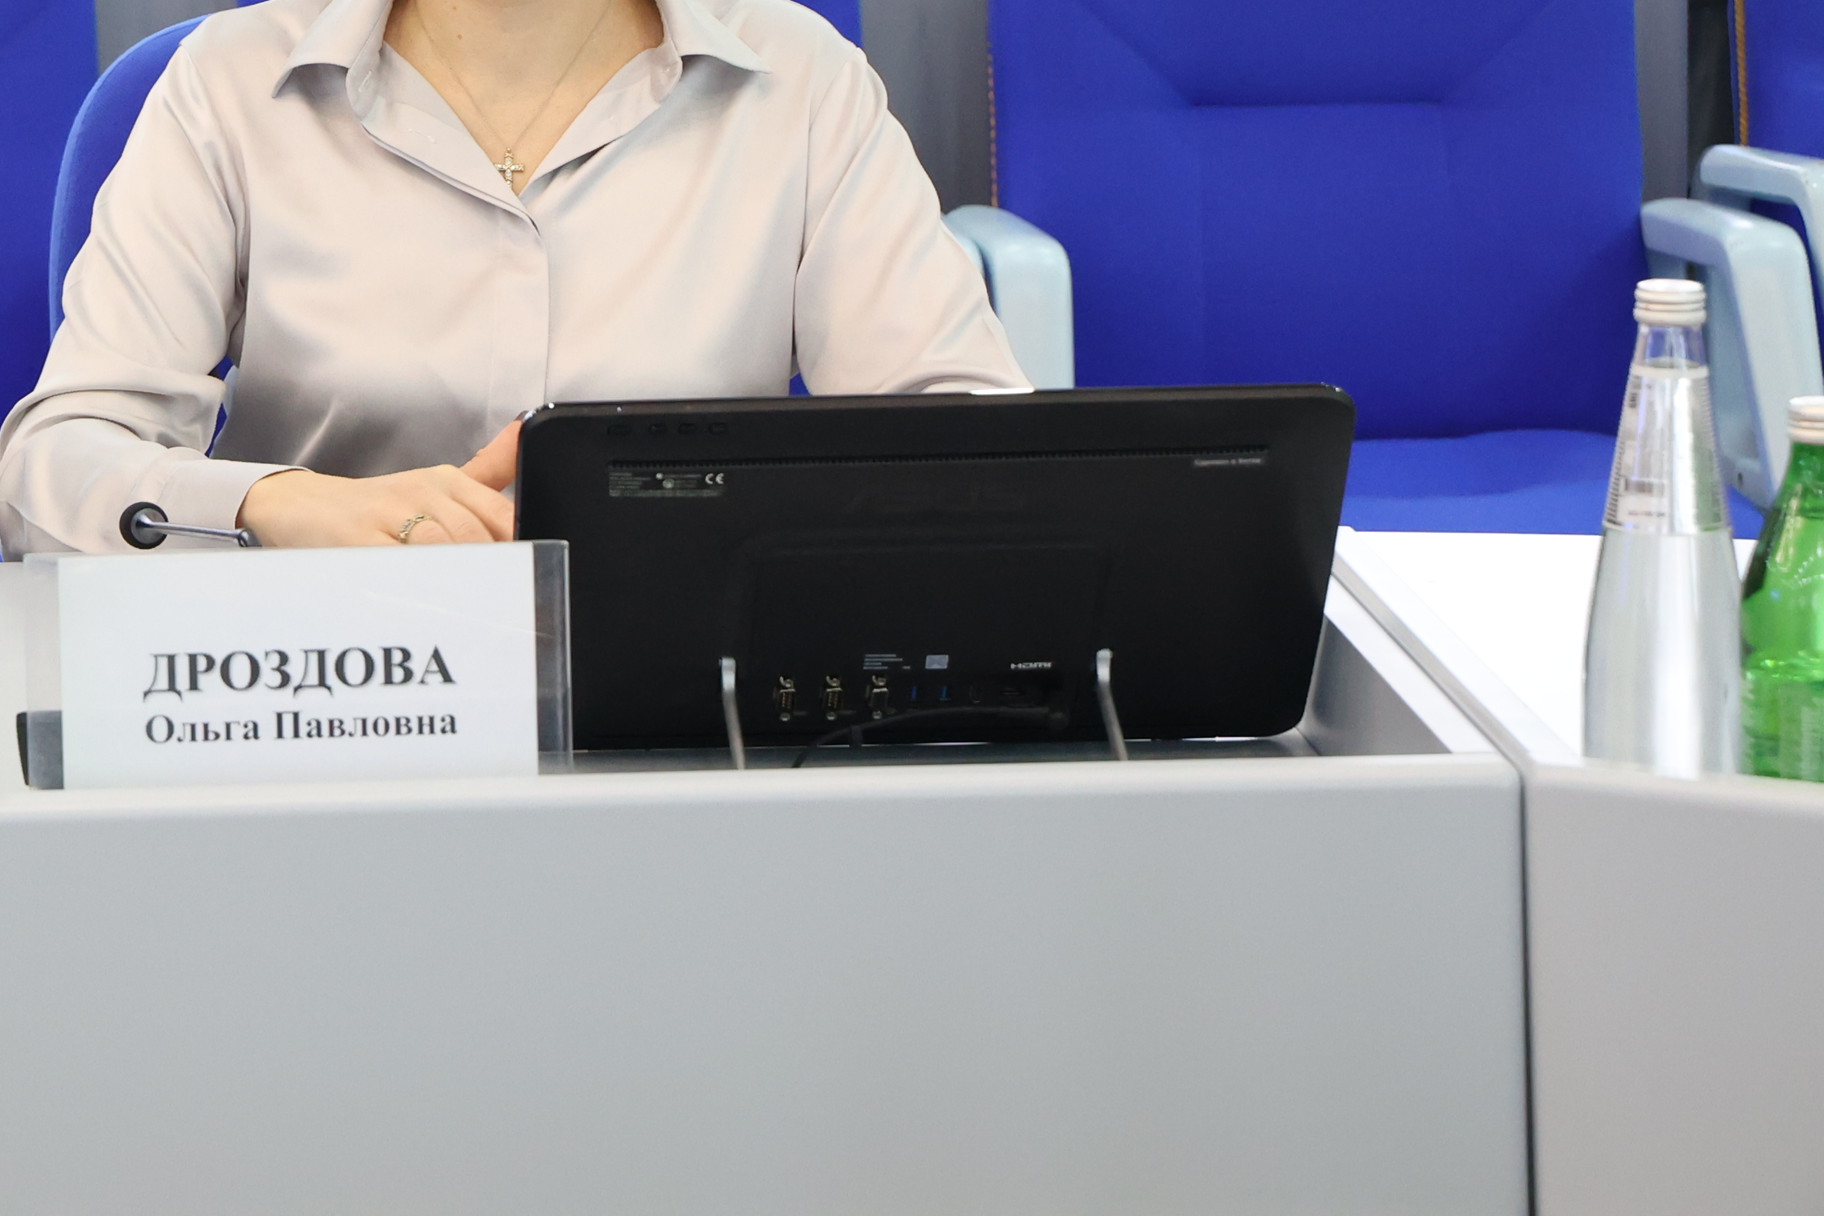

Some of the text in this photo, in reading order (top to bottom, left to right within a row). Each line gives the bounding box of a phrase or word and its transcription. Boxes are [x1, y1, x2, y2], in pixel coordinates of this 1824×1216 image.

[143, 645, 457, 702] ДРОЗДОВА
[144, 710, 459, 744] Ольга Павловна
